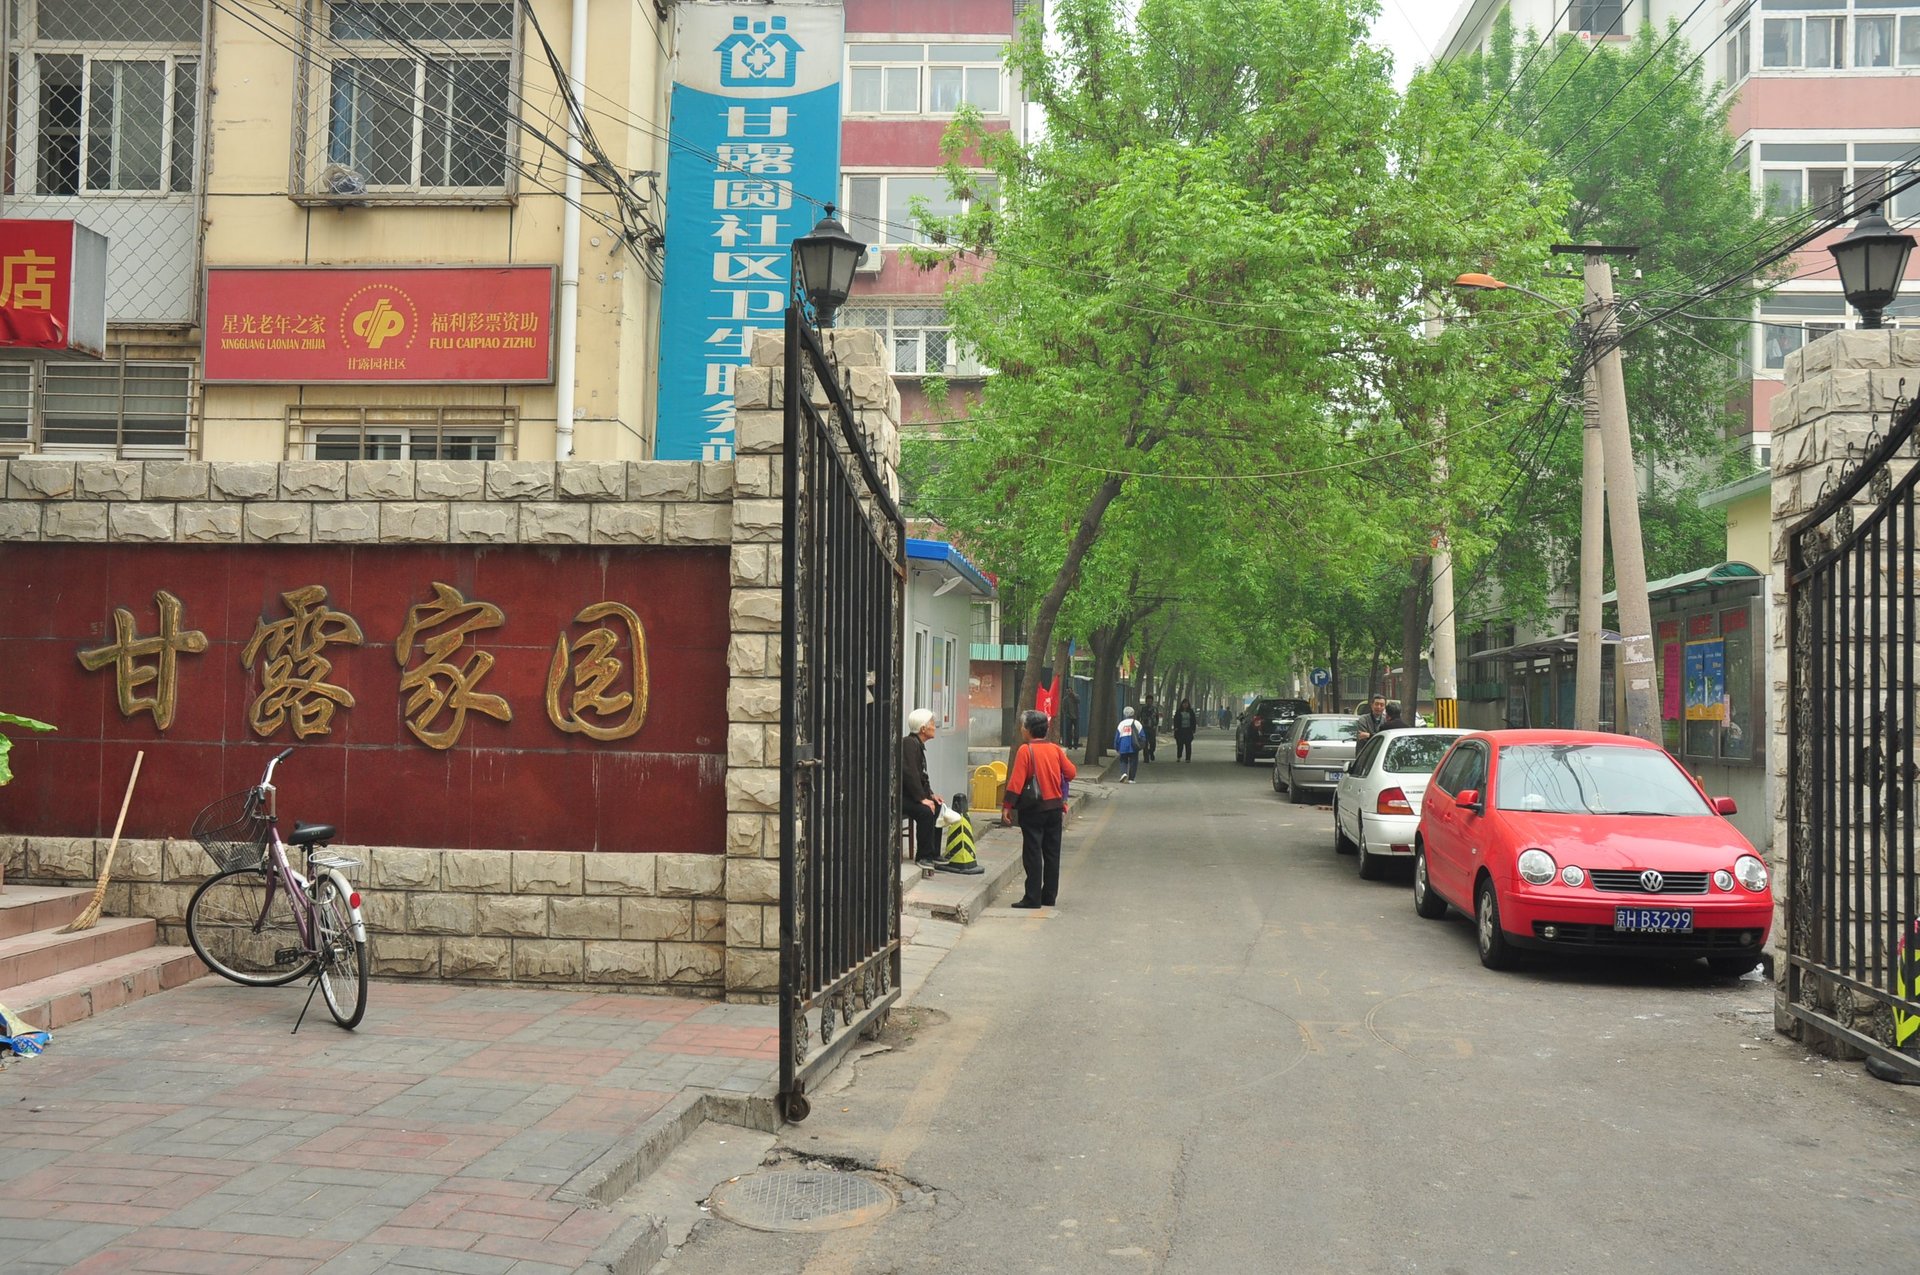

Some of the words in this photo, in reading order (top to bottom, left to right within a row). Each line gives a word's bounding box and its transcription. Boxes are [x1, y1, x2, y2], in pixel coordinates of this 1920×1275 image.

[0, 249, 56, 310] 店
[221, 314, 326, 335] 星光老年之家
[430, 312, 539, 333] 福利彩票资助
[221, 338, 265, 350] XINGGUANG
[267, 338, 299, 350] LAONIAN
[301, 338, 326, 350] ZHIJIA
[430, 337, 453, 349] FULI
[456, 337, 500, 349] CAIPIAO
[503, 337, 537, 348] ZIZHU
[348, 357, 407, 371] 甘露园社区
[76, 581, 649, 750] 甘露家园
